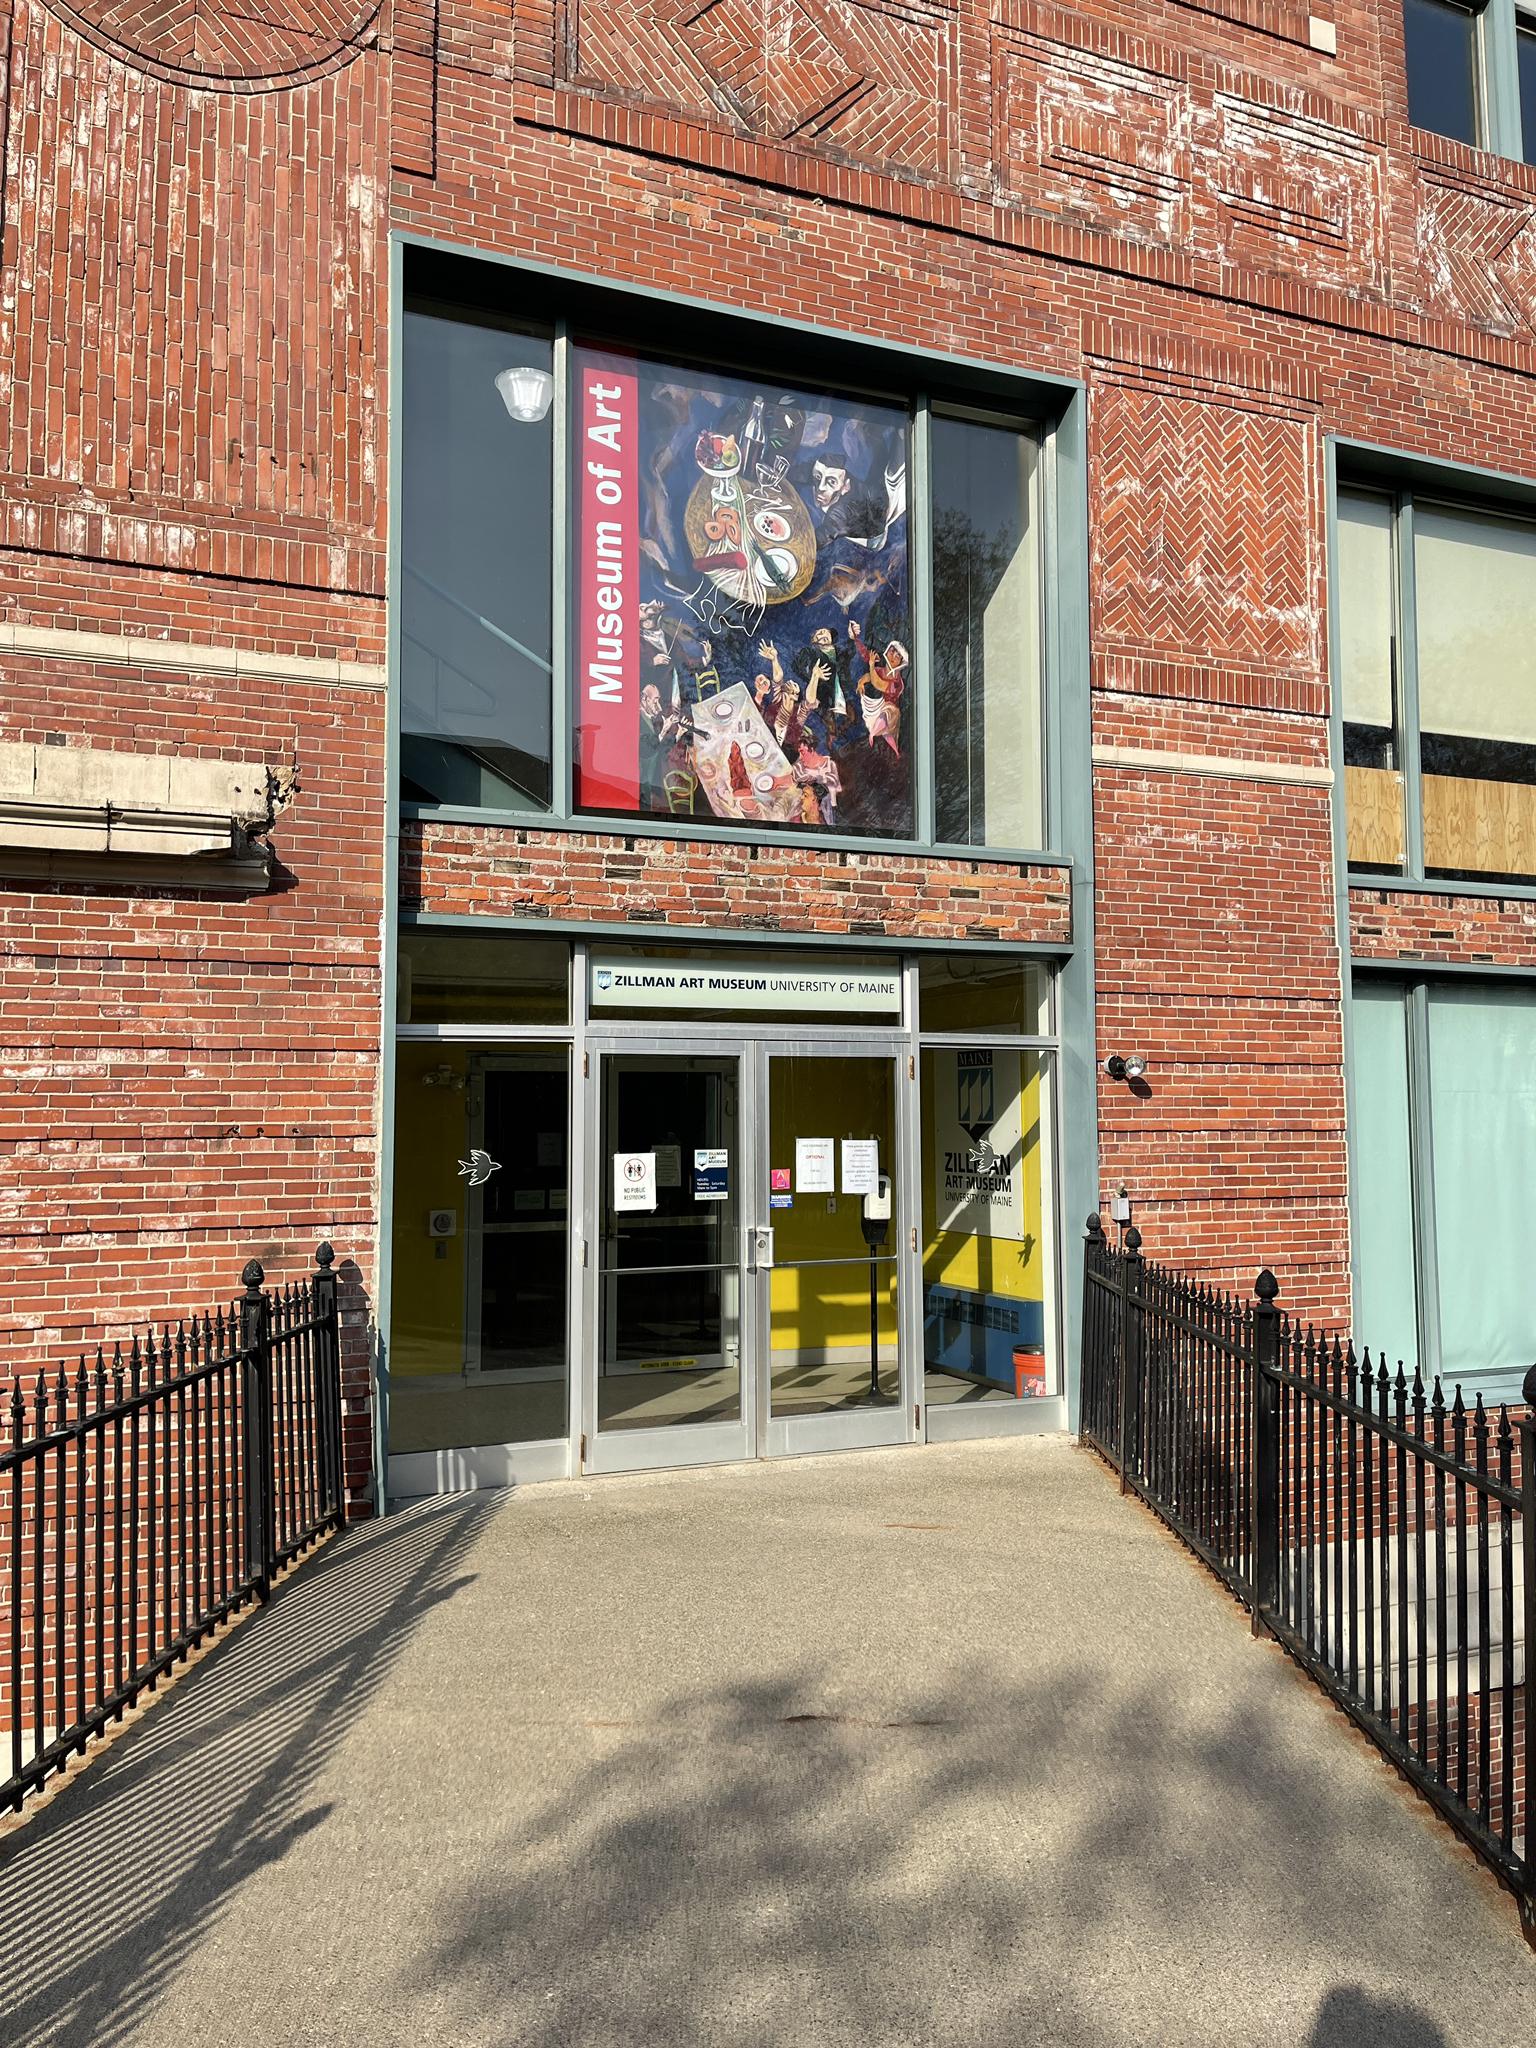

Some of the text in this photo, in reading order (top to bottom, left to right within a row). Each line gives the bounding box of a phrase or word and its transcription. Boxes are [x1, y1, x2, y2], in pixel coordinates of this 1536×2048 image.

[587, 383, 623, 703] Museum of Art
[614, 975, 895, 994] ZILLMAN ART MUSEUM UNIVERSITY OF MAINE
[959, 1051, 991, 1065] MAINE
[945, 1175, 1012, 1193] ART MUSEUM
[945, 1191, 1013, 1207] UNIVERSITY OF MAINE
